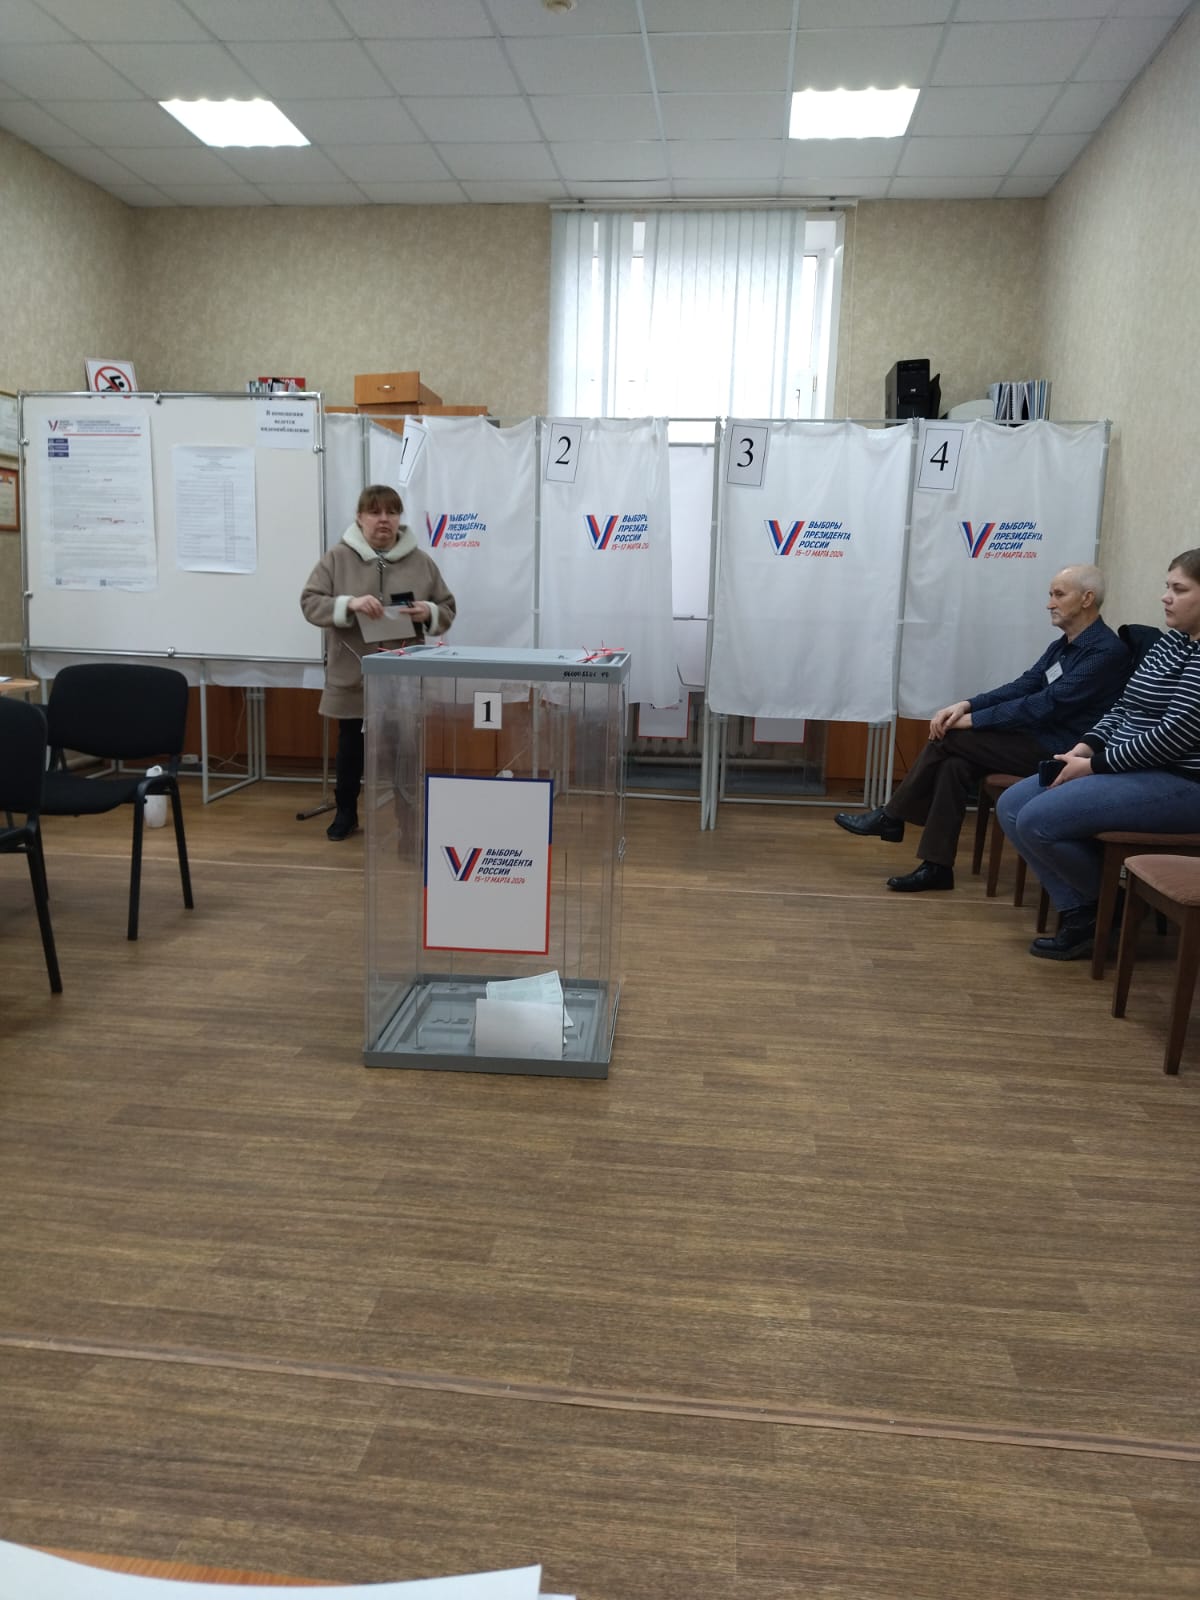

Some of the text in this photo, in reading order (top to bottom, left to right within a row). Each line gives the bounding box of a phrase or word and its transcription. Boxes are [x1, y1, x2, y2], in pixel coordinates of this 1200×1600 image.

[555, 436, 571, 465] 2
[737, 438, 754, 468] 3
[930, 441, 949, 471] 4
[808, 521, 843, 530] ВЫБОРЫ
[999, 522, 1037, 530] ВЫБОРЫ
[614, 534, 642, 543] РОССИИ
[803, 531, 852, 541] ПРЕЗИДЕНТА
[798, 541, 830, 549] РОССИИ
[988, 542, 1023, 550] РОССИИ
[811, 550, 829, 558] МАРТА
[1001, 551, 1022, 559] МАРТА
[1022, 551, 1038, 559] 2024
[482, 700, 495, 723] 1
[486, 848, 523, 857] ВЫБОРЫ
[481, 858, 533, 867] ПРЕЗИДЕНТА
[477, 867, 511, 875] РОССИИ
[490, 876, 510, 884] МАРТА
